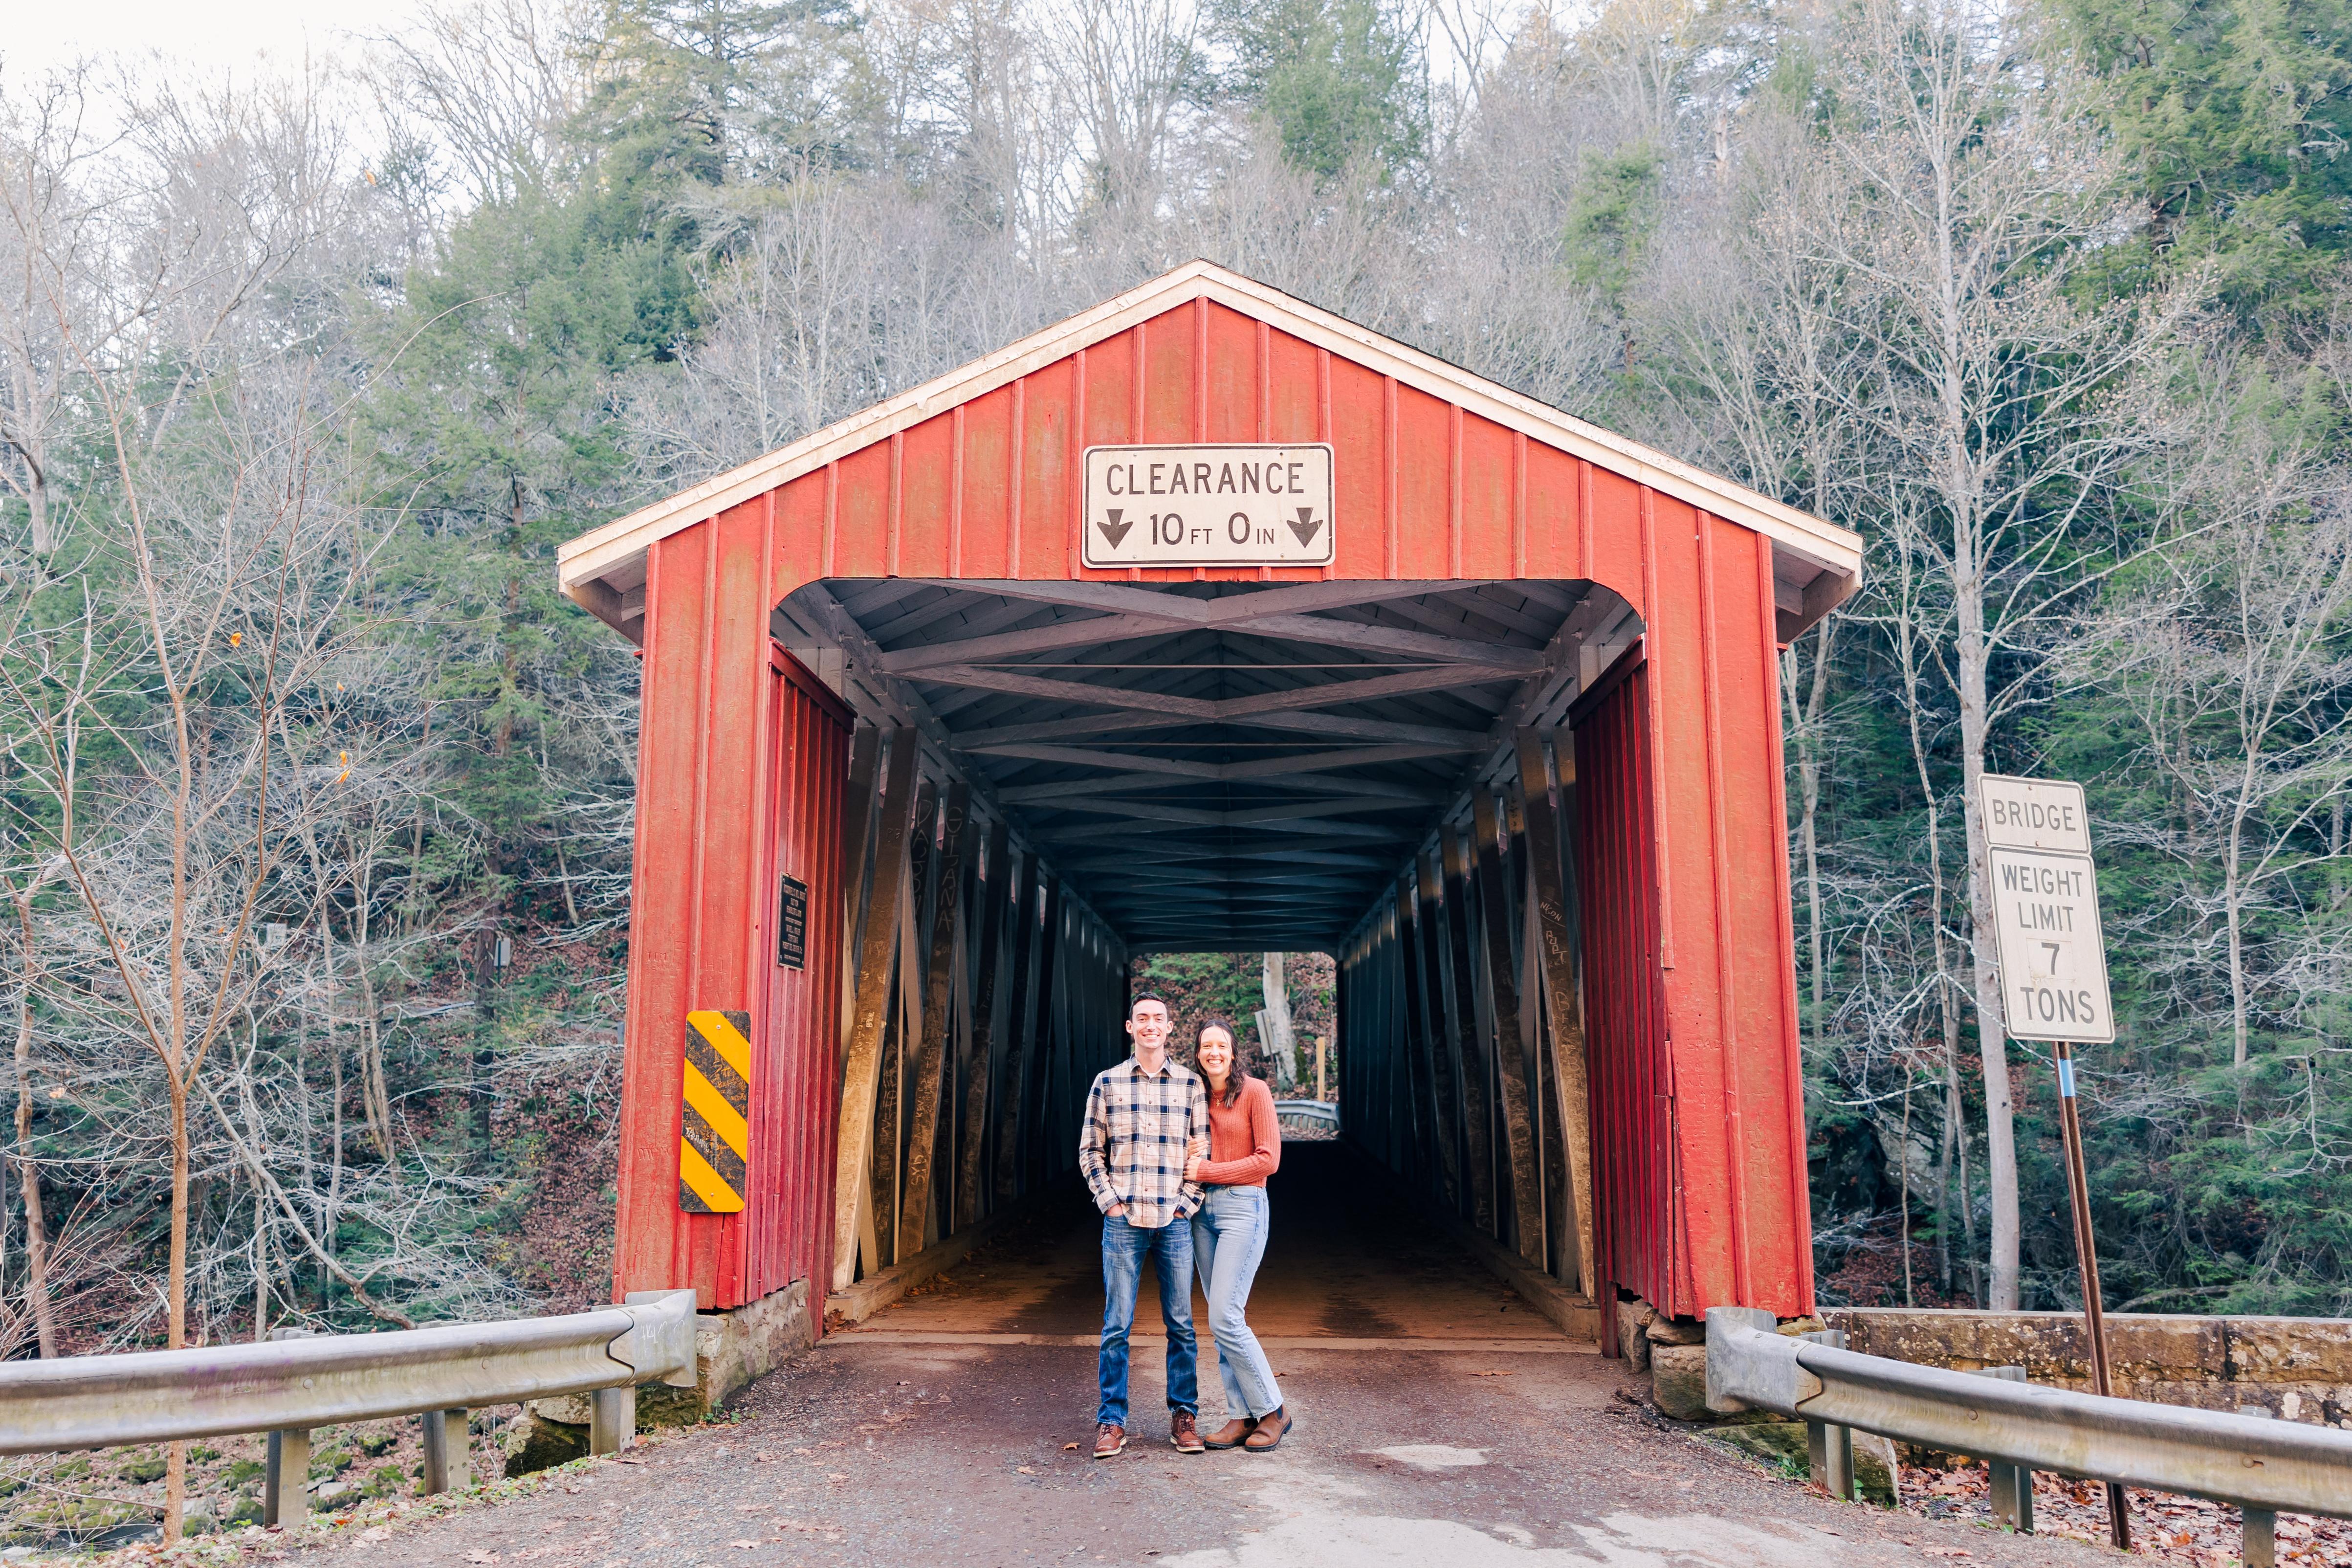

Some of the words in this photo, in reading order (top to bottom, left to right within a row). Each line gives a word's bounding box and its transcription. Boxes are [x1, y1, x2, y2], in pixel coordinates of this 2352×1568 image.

[1107, 463, 1304, 496] CLEARANCE
[1150, 513, 1184, 545] 10
[1191, 529, 1213, 545] FT
[1228, 512, 1250, 545] 0
[1257, 529, 1275, 545] IN
[1992, 798, 2076, 832] BRIDGE
[2001, 863, 2082, 897] WEIGHT
[2018, 902, 2073, 932] LIMIT
[2041, 942, 2060, 975] 7
[2020, 987, 2095, 1024] TONS
